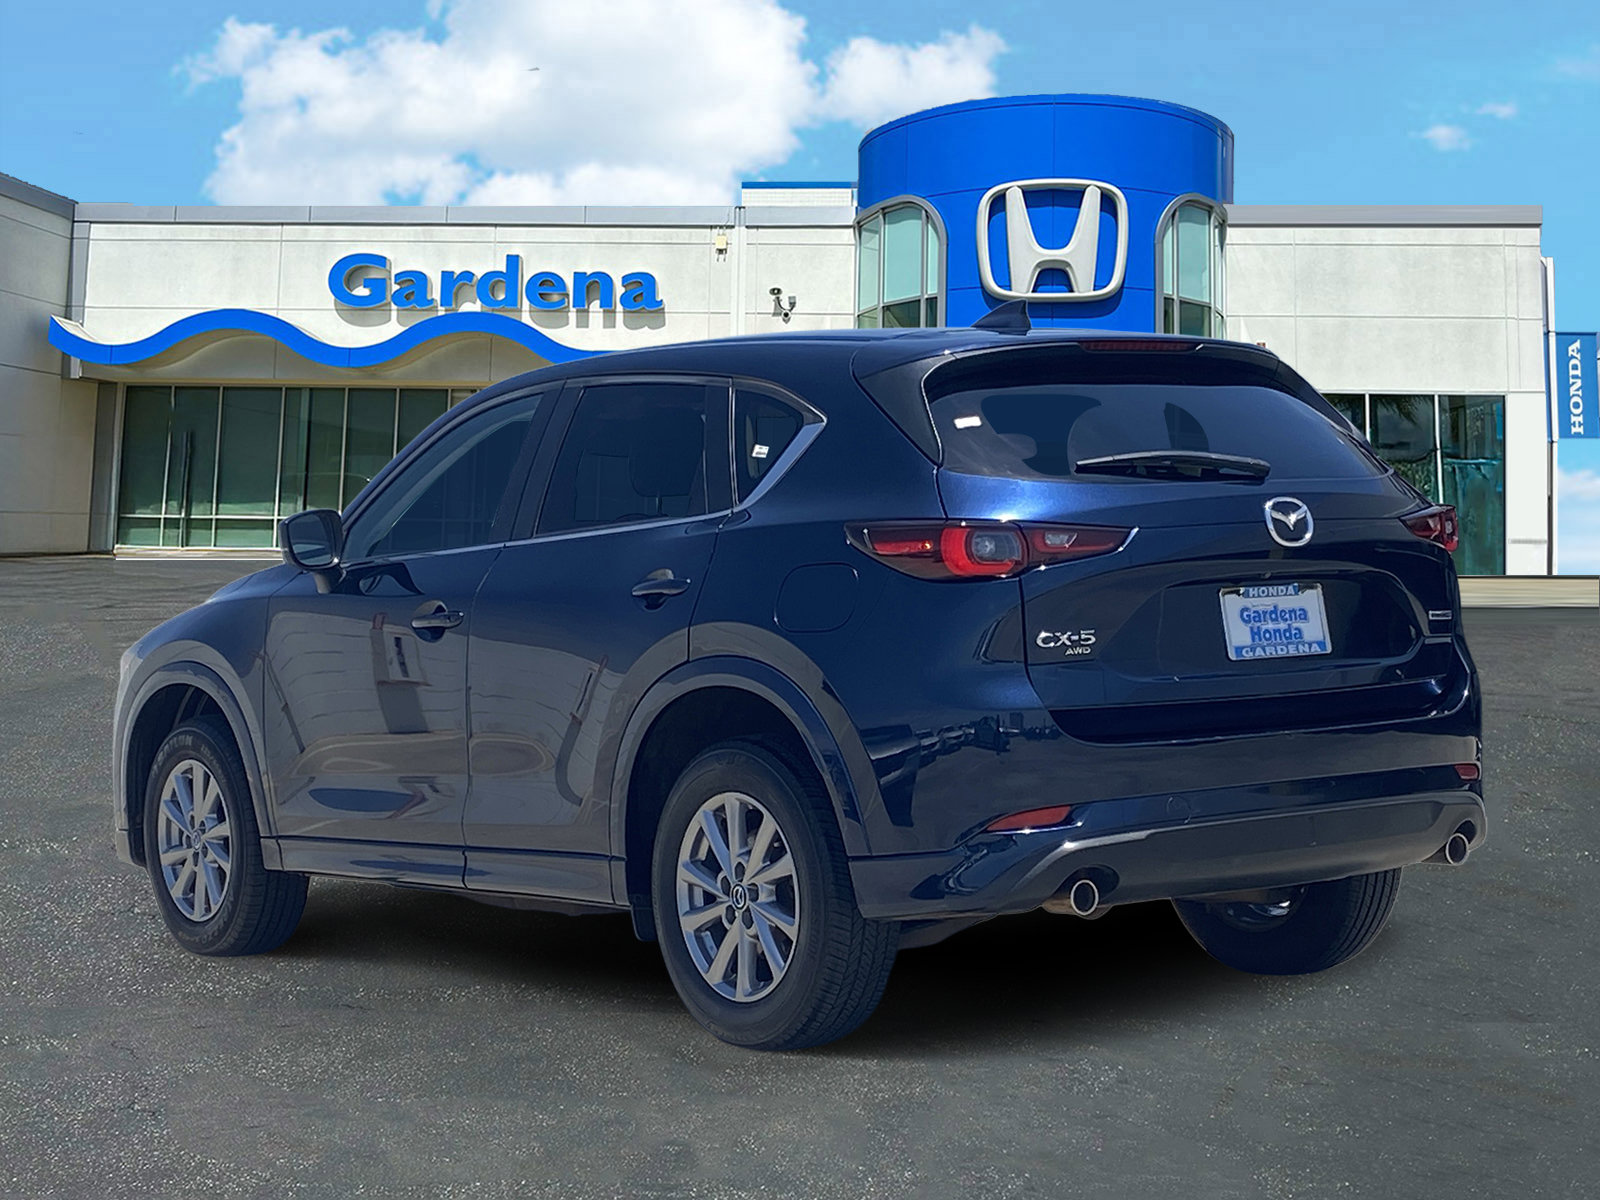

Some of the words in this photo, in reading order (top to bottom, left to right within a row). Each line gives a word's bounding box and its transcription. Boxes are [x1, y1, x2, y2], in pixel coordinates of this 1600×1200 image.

[328, 252, 664, 311] Gardena
[1568, 339, 1584, 435] HONDA
[1249, 586, 1295, 598] HONDA
[1239, 604, 1309, 624] Gardena
[1036, 629, 1096, 648] CX-5
[1249, 624, 1304, 643] Honda
[1064, 647, 1092, 656] AWD
[1241, 642, 1321, 658] GARDENA
